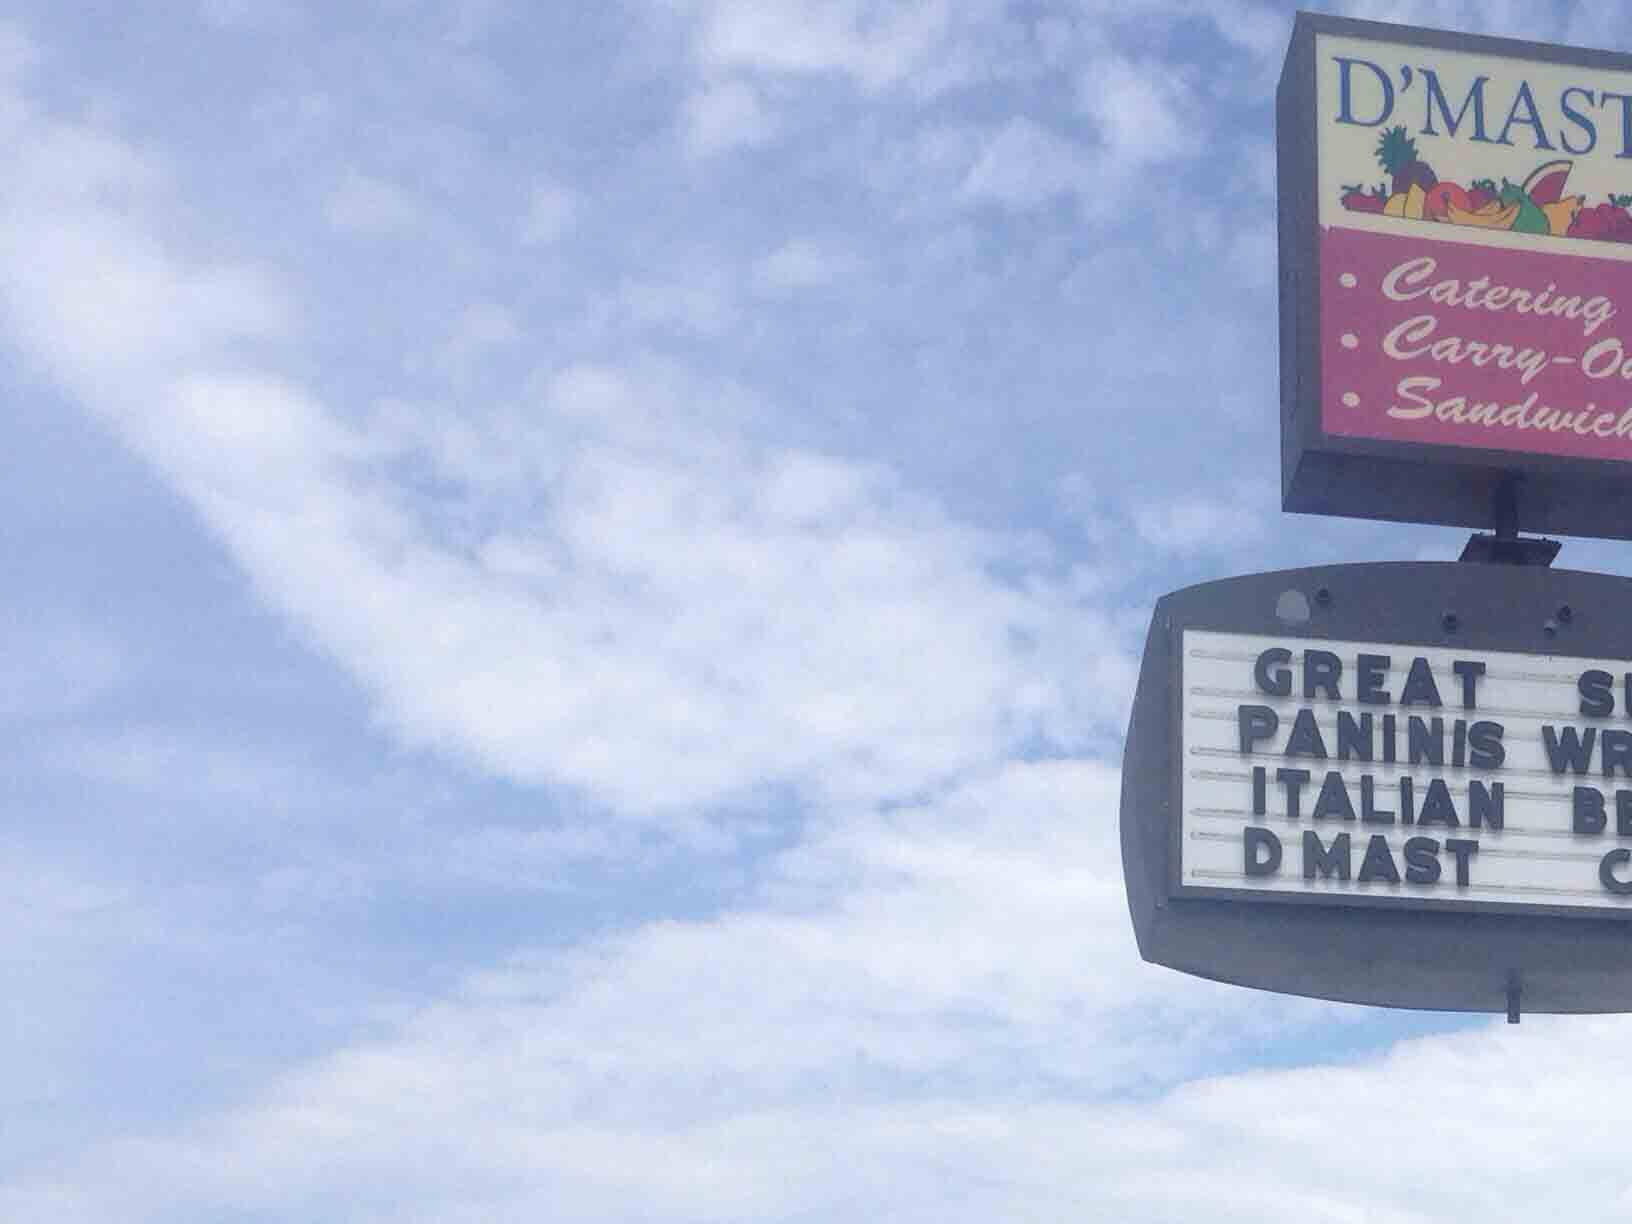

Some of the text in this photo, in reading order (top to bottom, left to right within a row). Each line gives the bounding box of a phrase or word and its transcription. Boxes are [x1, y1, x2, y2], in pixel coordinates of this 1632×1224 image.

[1381, 257, 1618, 335] Catering
[1253, 646, 1487, 711] GREAT
[1236, 703, 1507, 769] PANINIS
[1251, 766, 1506, 831] ITALIAN
